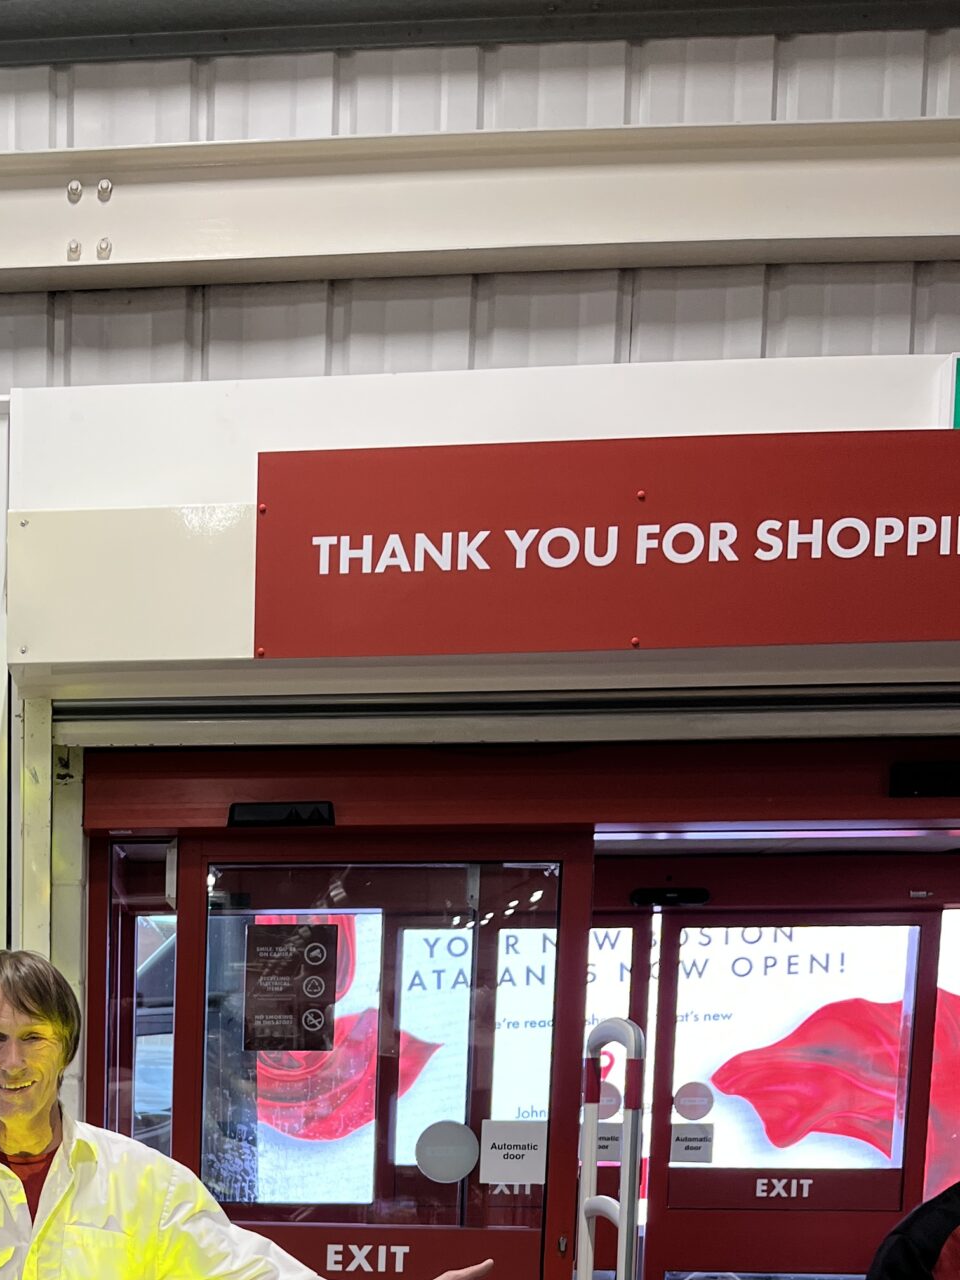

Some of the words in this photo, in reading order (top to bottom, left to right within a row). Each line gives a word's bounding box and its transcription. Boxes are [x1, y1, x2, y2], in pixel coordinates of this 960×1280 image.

[312, 530, 491, 575] THANK
[505, 526, 618, 569] YOU
[635, 522, 739, 565] FOR
[753, 515, 960, 561] SHOPPI
[423, 934, 520, 959] YOR
[731, 951, 845, 978] OPEN!
[703, 1012, 732, 1021] new
[490, 1142, 538, 1151] Automatic
[503, 1151, 525, 1160] door
[755, 1178, 813, 1197] EXIT
[326, 1244, 410, 1273] EXIT
